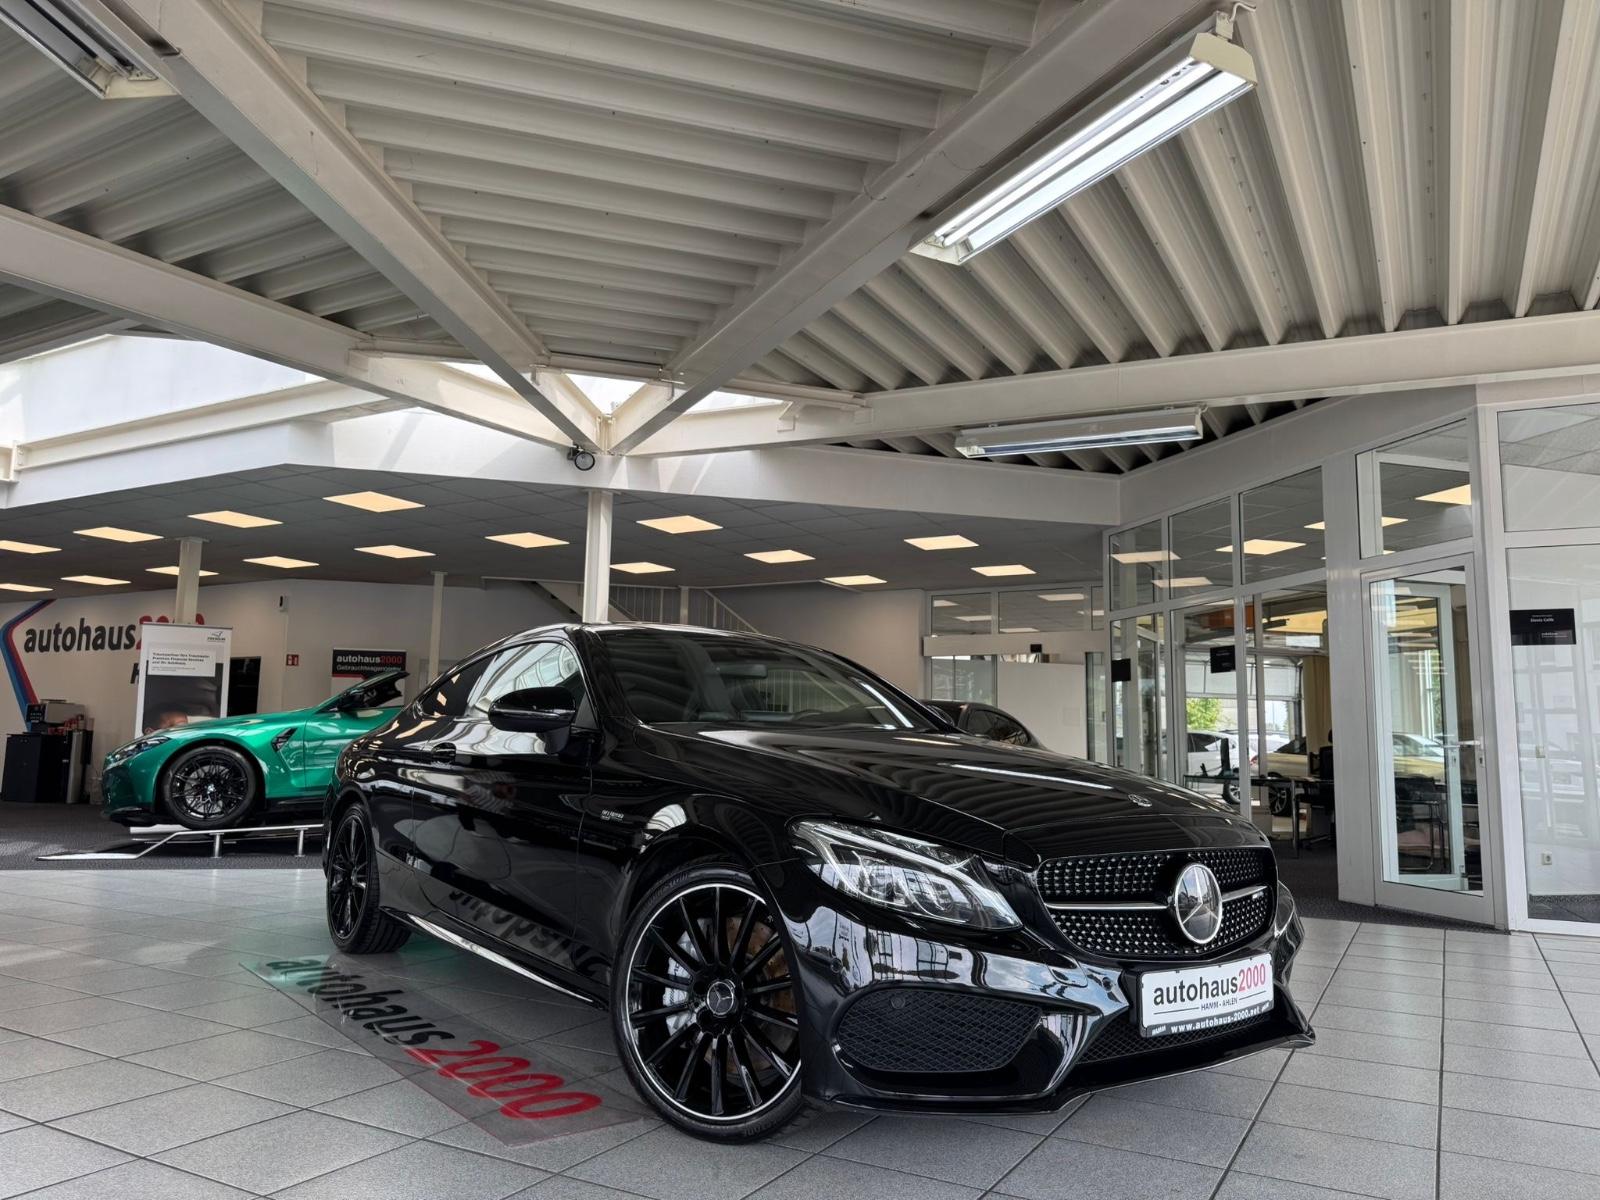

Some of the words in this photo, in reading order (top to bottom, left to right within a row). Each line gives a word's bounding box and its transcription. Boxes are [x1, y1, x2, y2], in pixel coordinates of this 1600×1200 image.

[24, 613, 205, 653] autohaus
[336, 654, 402, 664] autohaus2000
[1153, 963, 1266, 1006] autohaus2000
[1201, 1001, 1219, 1011] HAMM
[1222, 997, 1238, 1007] AHLEN
[266, 958, 604, 1120] autohaus2000
